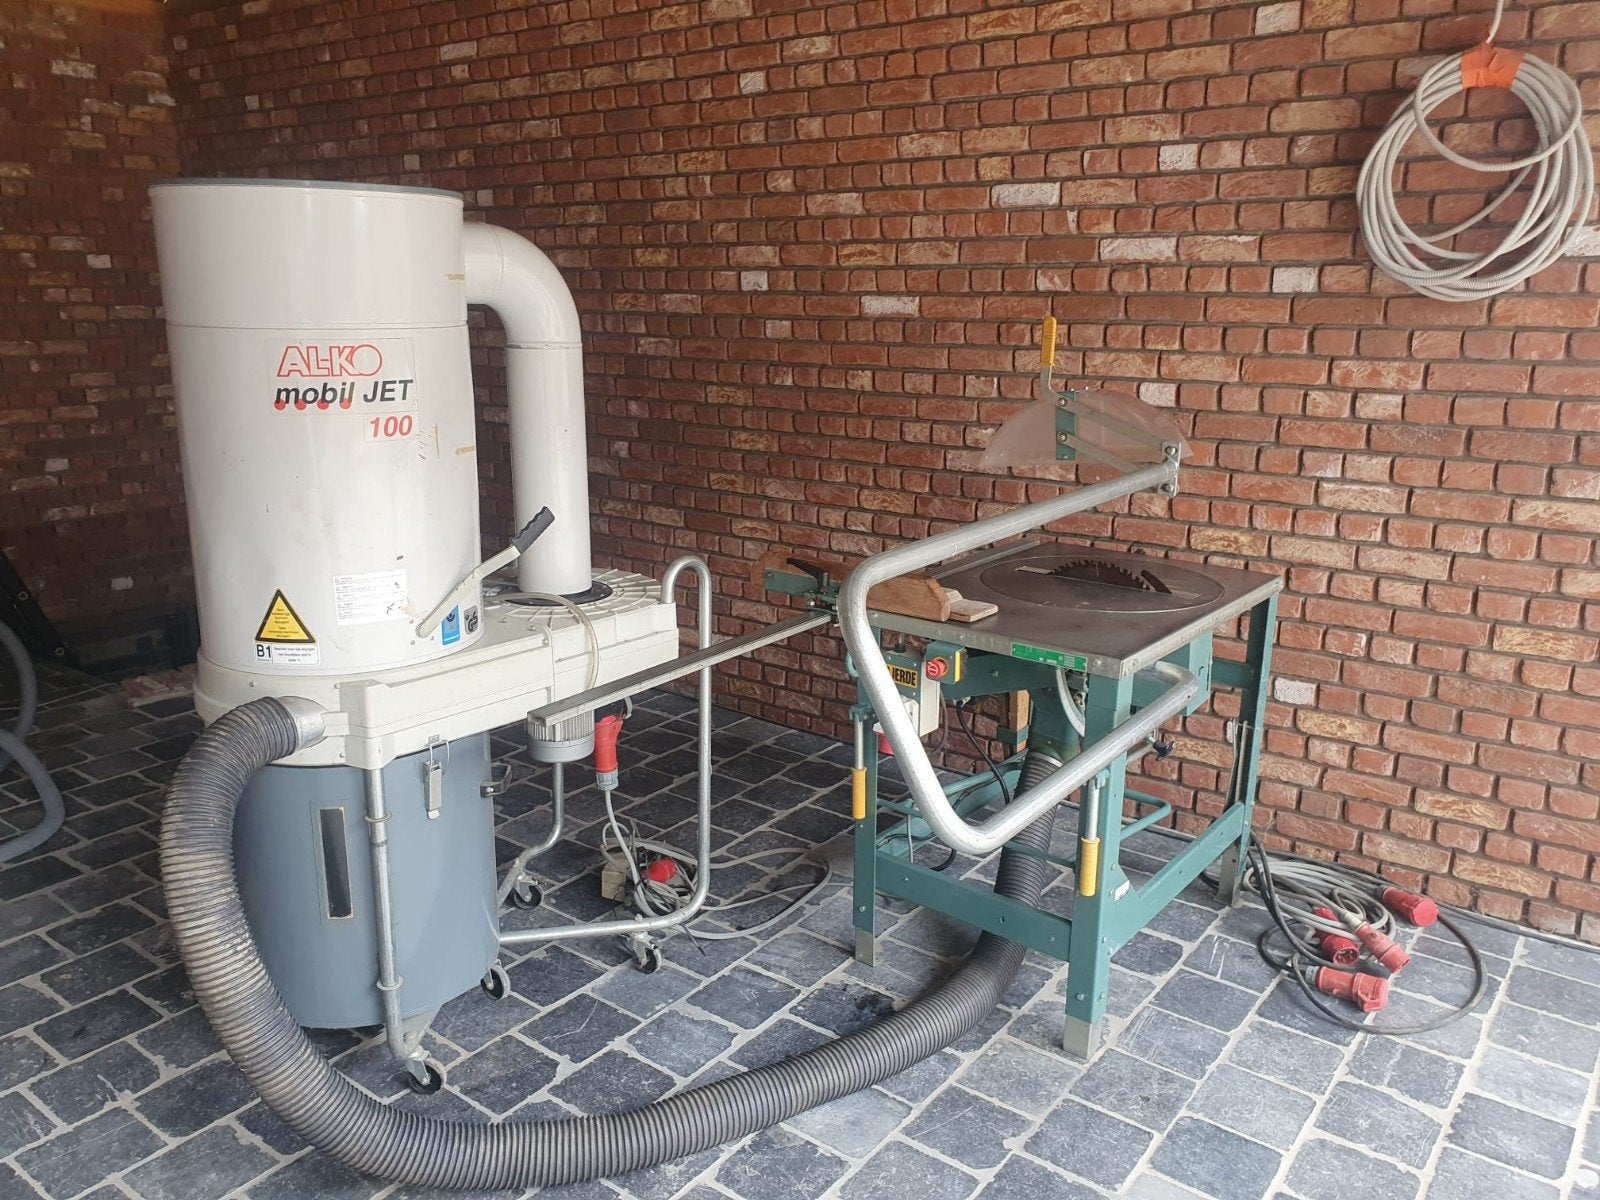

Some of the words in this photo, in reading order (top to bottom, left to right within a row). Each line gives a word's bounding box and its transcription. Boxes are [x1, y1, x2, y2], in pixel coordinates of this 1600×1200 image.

[277, 344, 383, 377] AL-KO
[275, 382, 354, 404] mobil
[363, 379, 413, 403] JET
[369, 414, 413, 438] 100
[256, 644, 271, 658] B1
